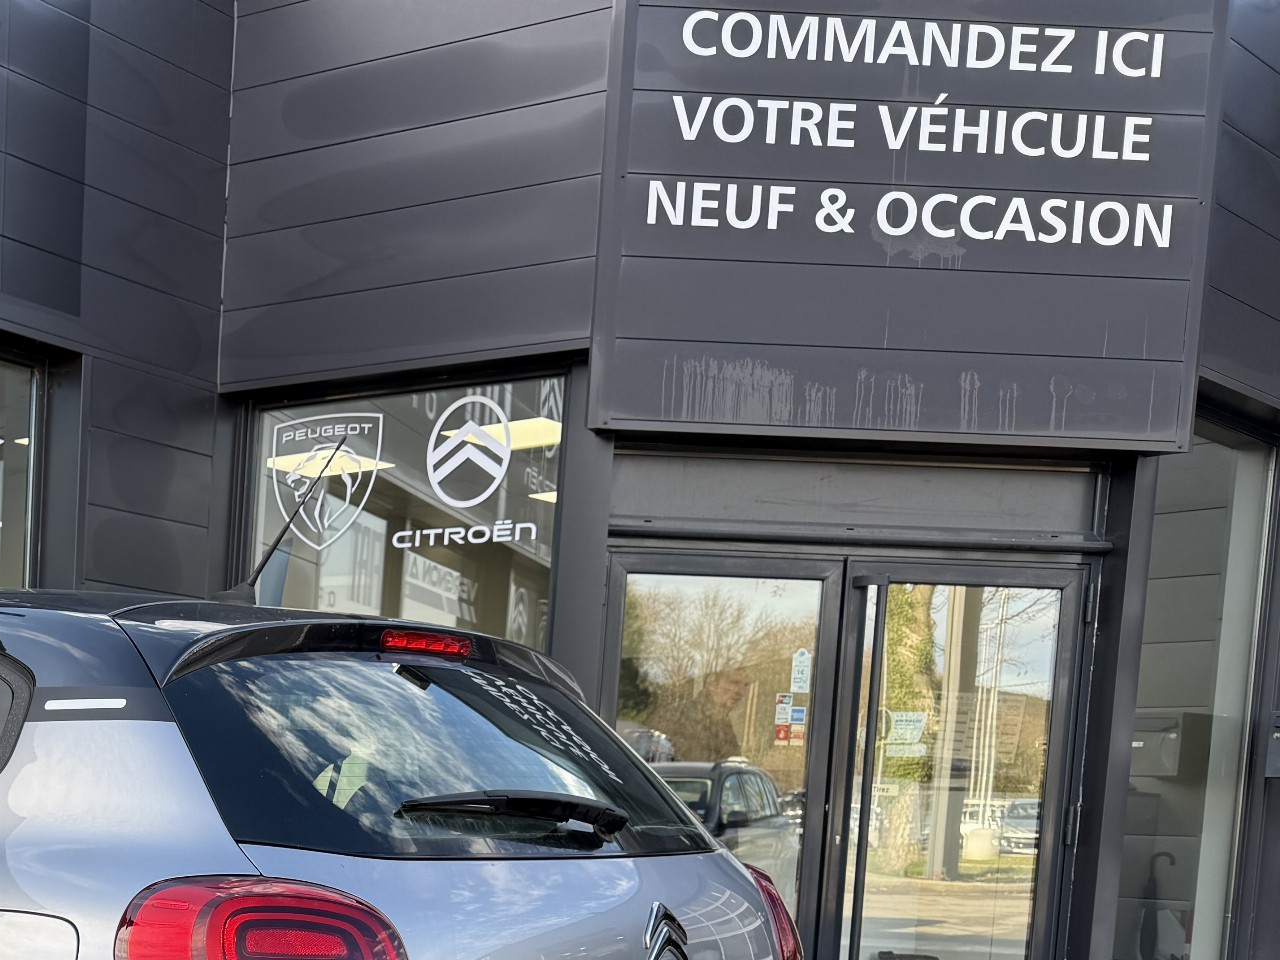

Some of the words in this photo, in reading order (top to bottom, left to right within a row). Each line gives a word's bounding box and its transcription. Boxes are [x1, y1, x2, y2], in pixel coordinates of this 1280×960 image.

[682, 9, 1075, 74] COMMANDEZ
[1094, 30, 1165, 78] ICI
[672, 96, 856, 148] VOTRE
[878, 92, 1152, 161] VÉHICULE
[646, 180, 797, 230] NEUF
[815, 187, 856, 234] &
[876, 190, 1173, 248] OCCASION
[281, 423, 373, 444] PEUGEOT
[391, 519, 537, 549] CITROËN
[872, 785, 889, 794] Tirez
